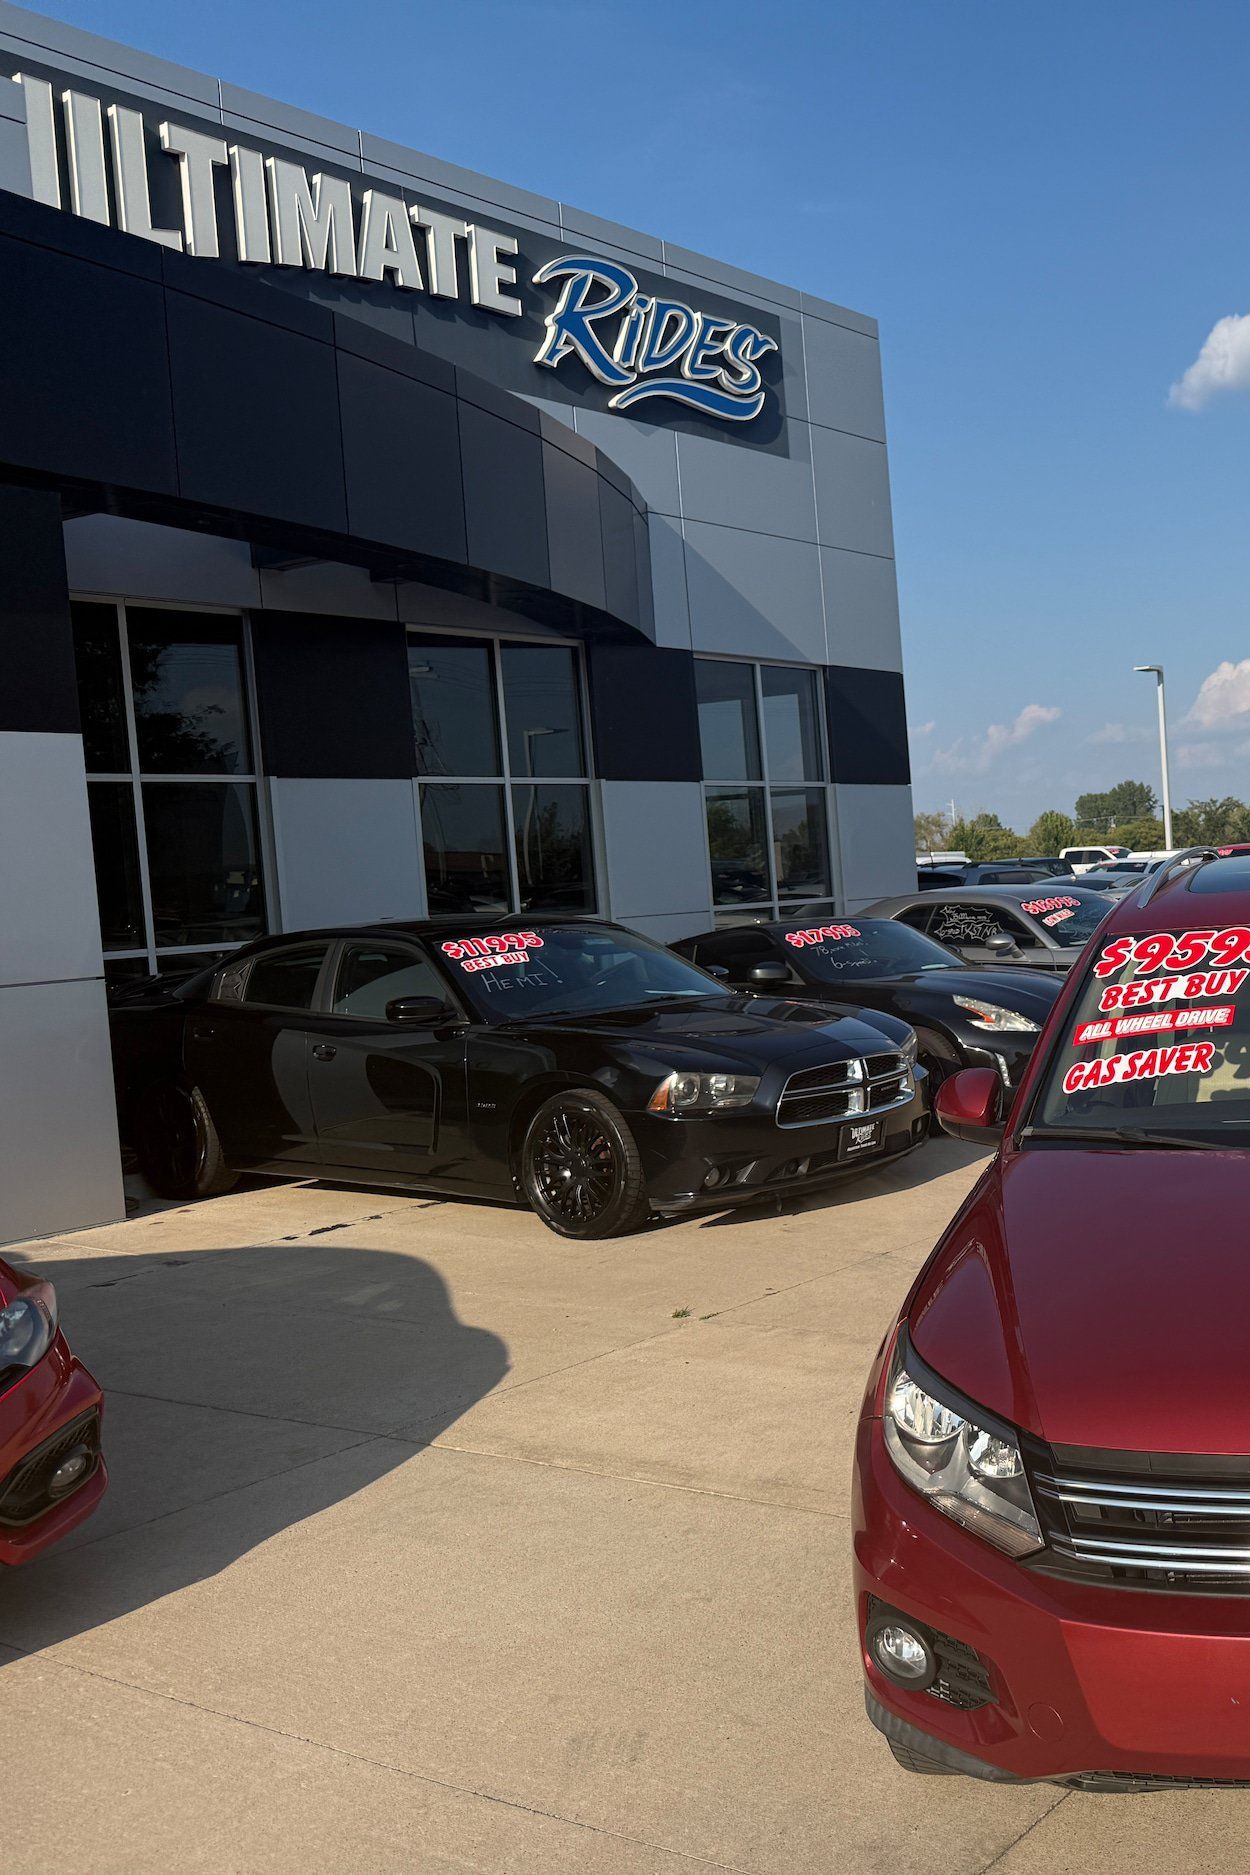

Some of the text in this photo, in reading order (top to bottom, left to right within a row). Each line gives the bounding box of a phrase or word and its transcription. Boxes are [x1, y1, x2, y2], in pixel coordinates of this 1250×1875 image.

[13, 71, 523, 318] ULTIMATE
[441, 931, 545, 959] $11995
[785, 924, 861, 948] $17995
[461, 951, 530, 972] BEST BUY
[1099, 968, 1250, 1012] BEST BUY
[1079, 1007, 1231, 1042] ALL WHEEL DRIVE
[1063, 1042, 1216, 1095] GAS SAVER
